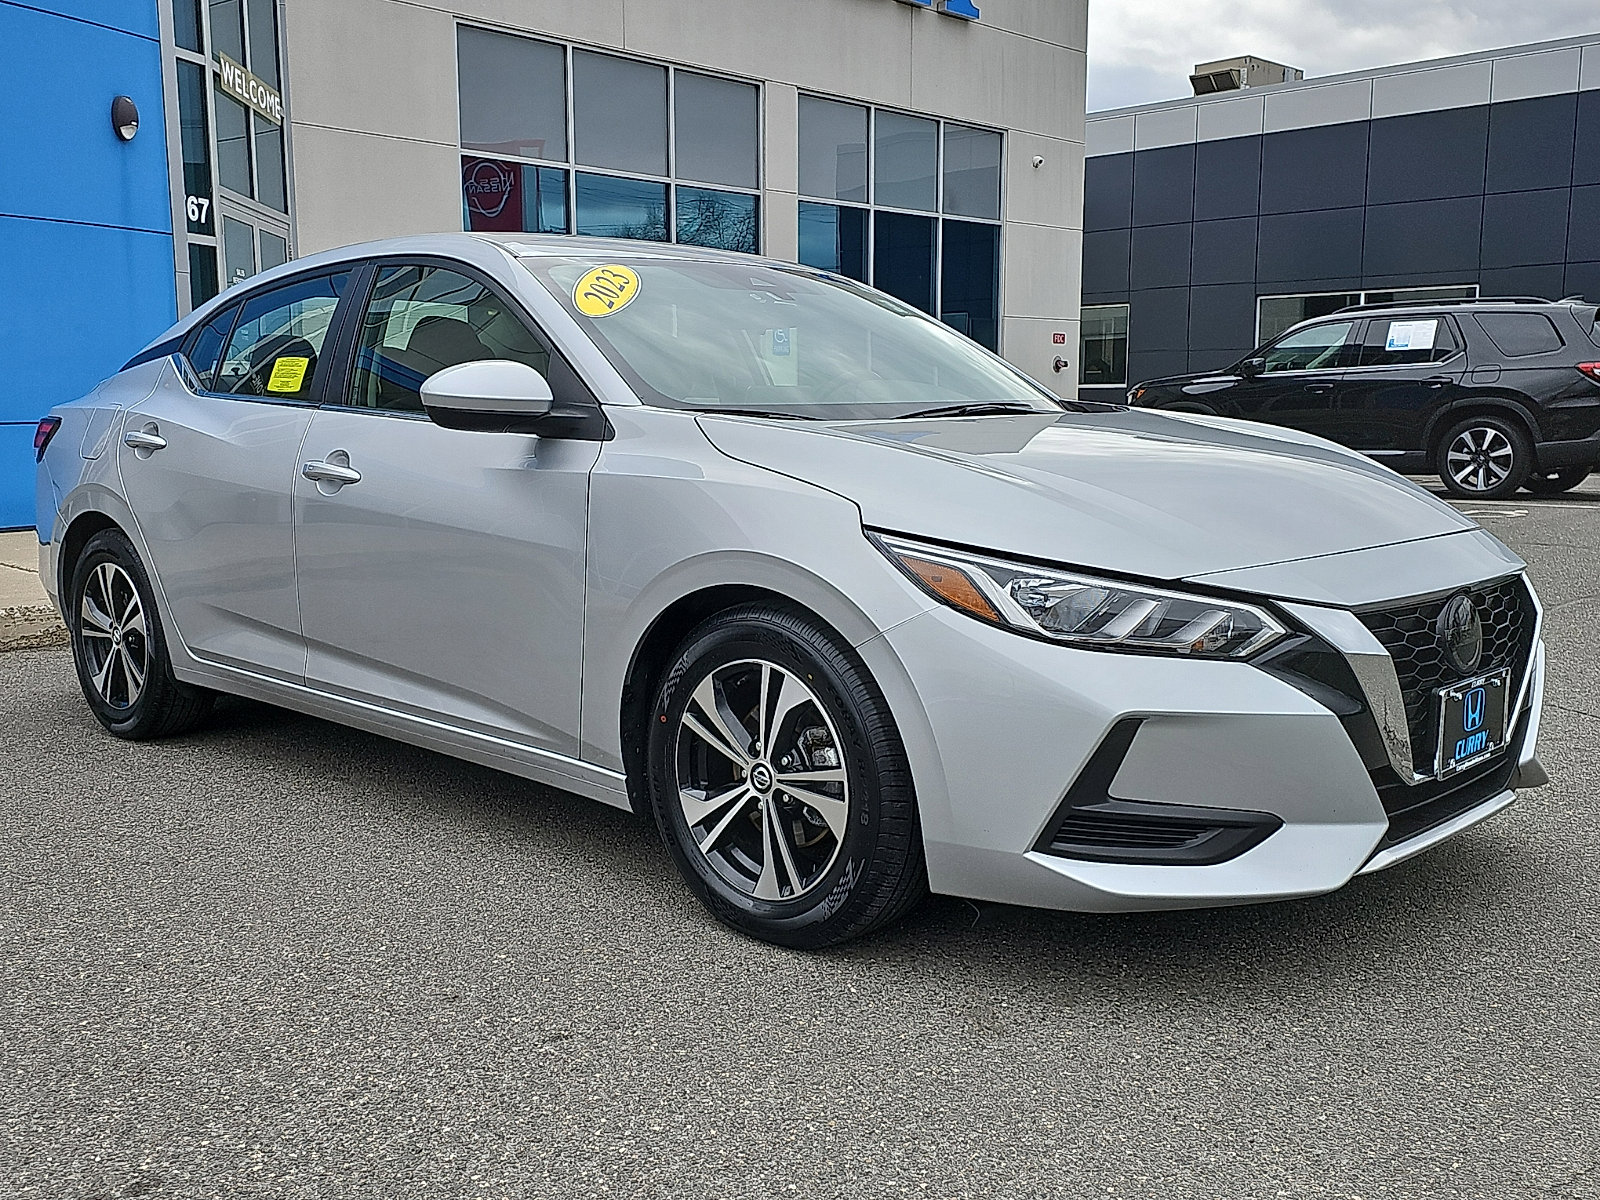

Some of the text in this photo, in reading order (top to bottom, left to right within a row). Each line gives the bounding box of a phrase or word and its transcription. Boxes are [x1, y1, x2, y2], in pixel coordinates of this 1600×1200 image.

[220, 57, 281, 120] WELCOME
[187, 195, 210, 224] 67
[584, 269, 630, 310] 2023
[1054, 334, 1065, 343] FDC
[1456, 729, 1490, 761] CURRY
